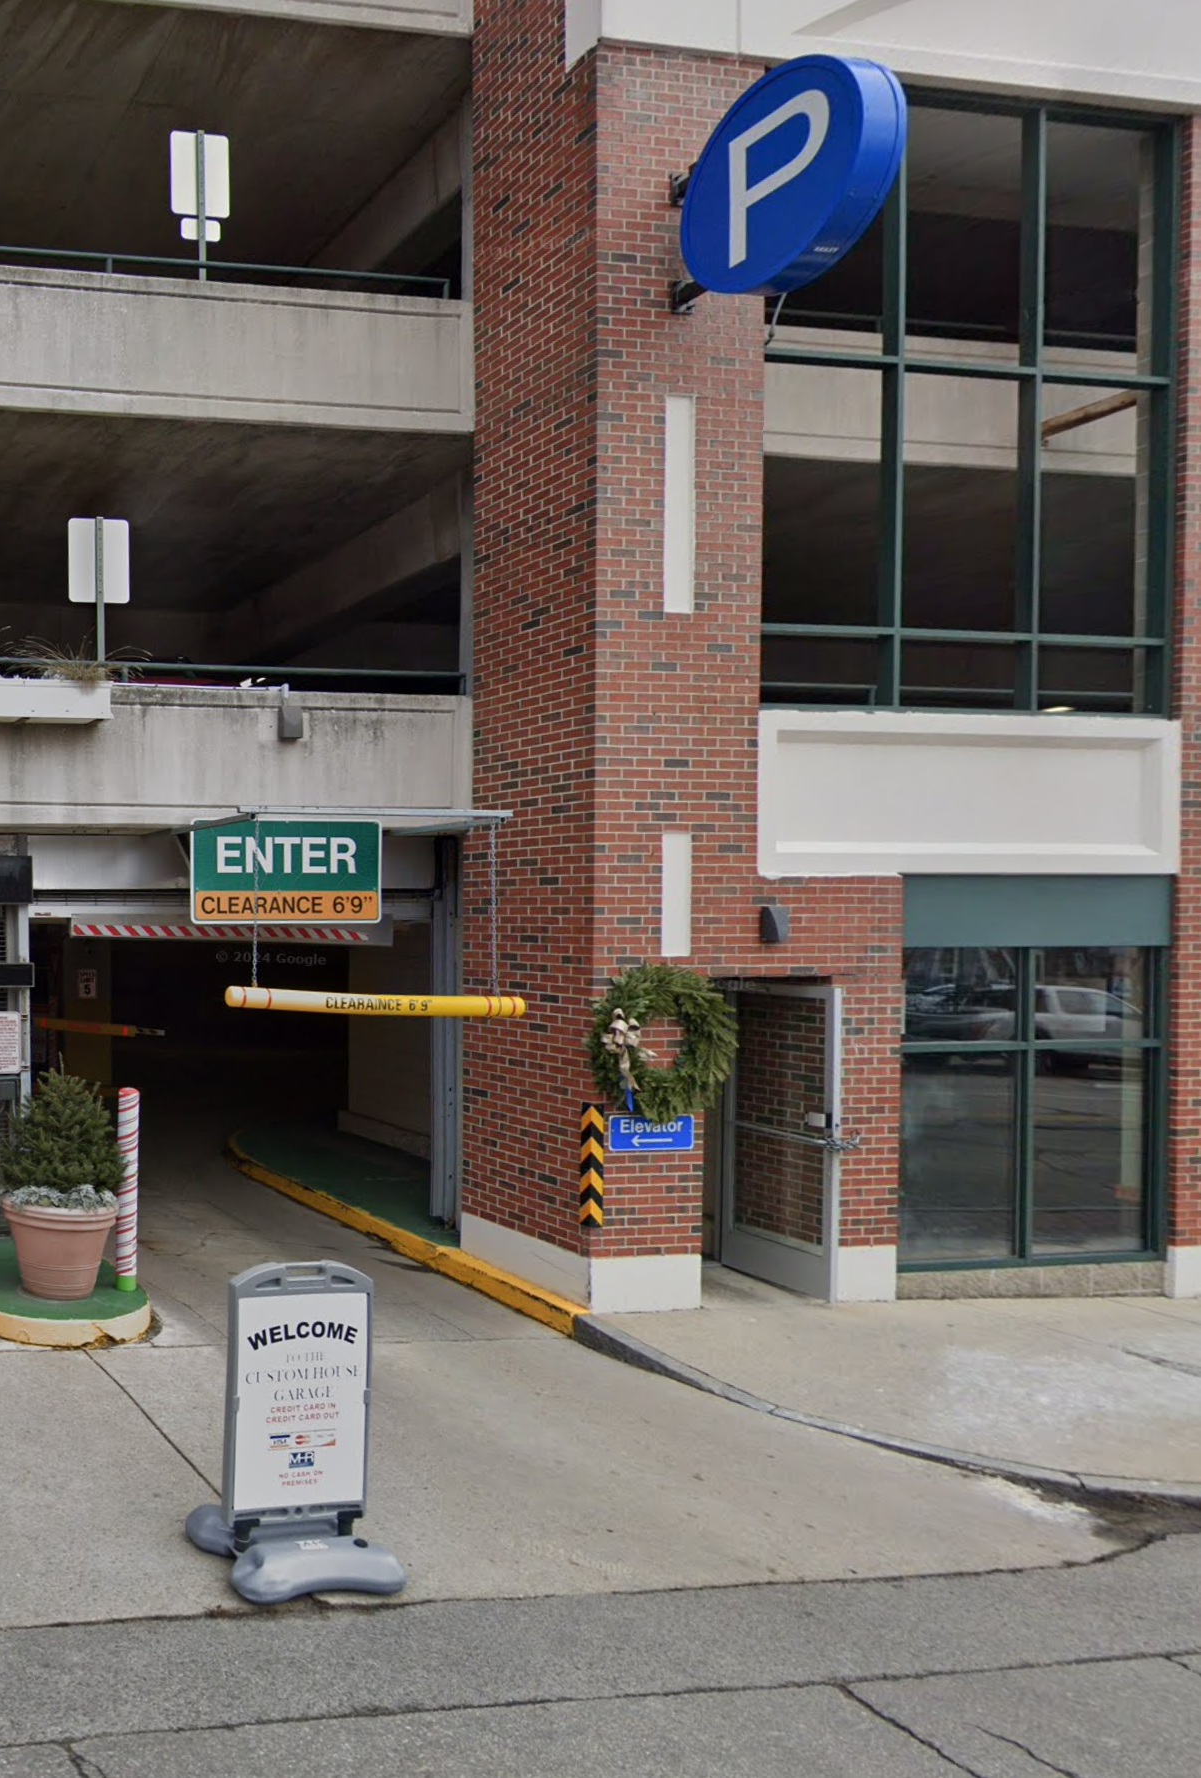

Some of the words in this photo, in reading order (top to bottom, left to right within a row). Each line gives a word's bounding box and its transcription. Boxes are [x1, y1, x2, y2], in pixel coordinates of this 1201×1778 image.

[728, 89, 830, 268] P
[216, 836, 357, 874] ENTER
[201, 896, 323, 914] CLEARANCE
[84, 984, 91, 995] 5
[247, 1321, 358, 1351] WELCOME
[305, 1351, 325, 1362] THE
[274, 1385, 333, 1401] GARAGE
[270, 1405, 300, 1413] CREDIT
[303, 1403, 325, 1411] CARD
[266, 1415, 296, 1423] CREDIT
[299, 1413, 321, 1421] CARD
[323, 1411, 340, 1419] OUT
[281, 1478, 317, 1486] PREMISES
